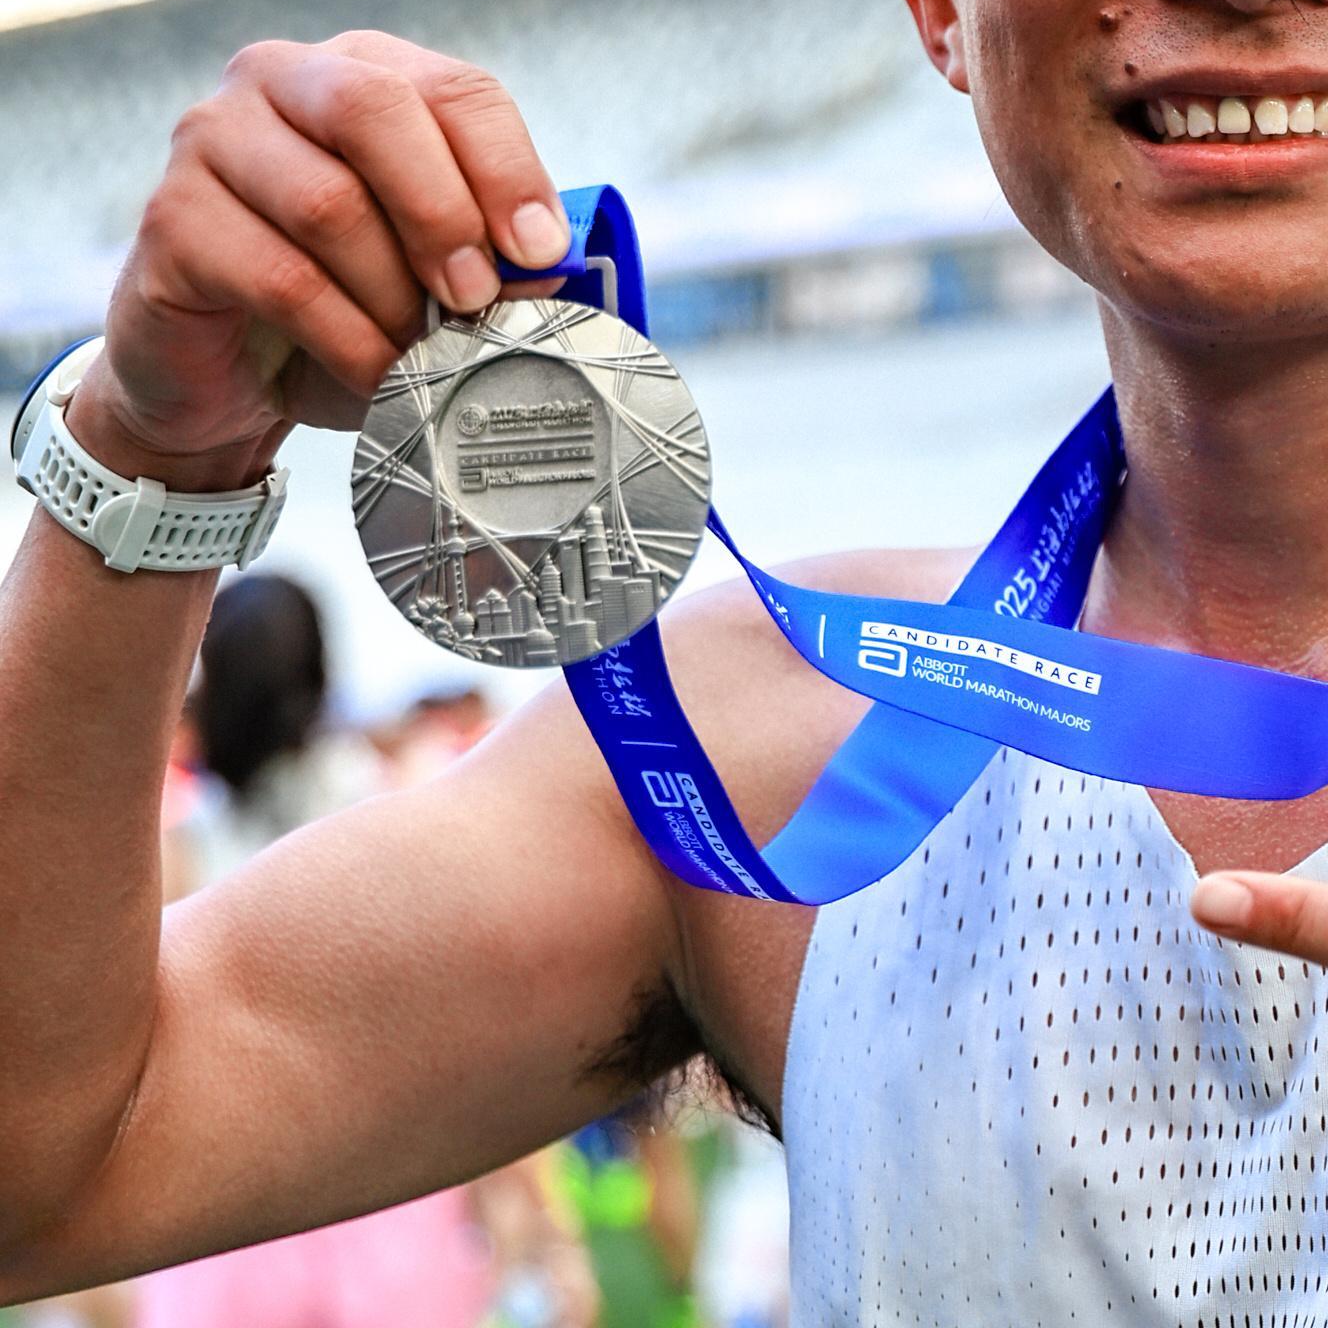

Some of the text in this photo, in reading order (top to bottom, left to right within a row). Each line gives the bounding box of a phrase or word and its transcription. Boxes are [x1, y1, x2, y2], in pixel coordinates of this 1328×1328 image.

[868, 624, 1095, 690] CANDIDATE RACE
[912, 655, 968, 677] ABBOTT
[911, 666, 1093, 733] WORLD MARATHON MAJORS
[663, 810, 692, 850] WORLD
[674, 811, 704, 851] ABBOTT
[681, 777, 750, 879] CANDIDATE
